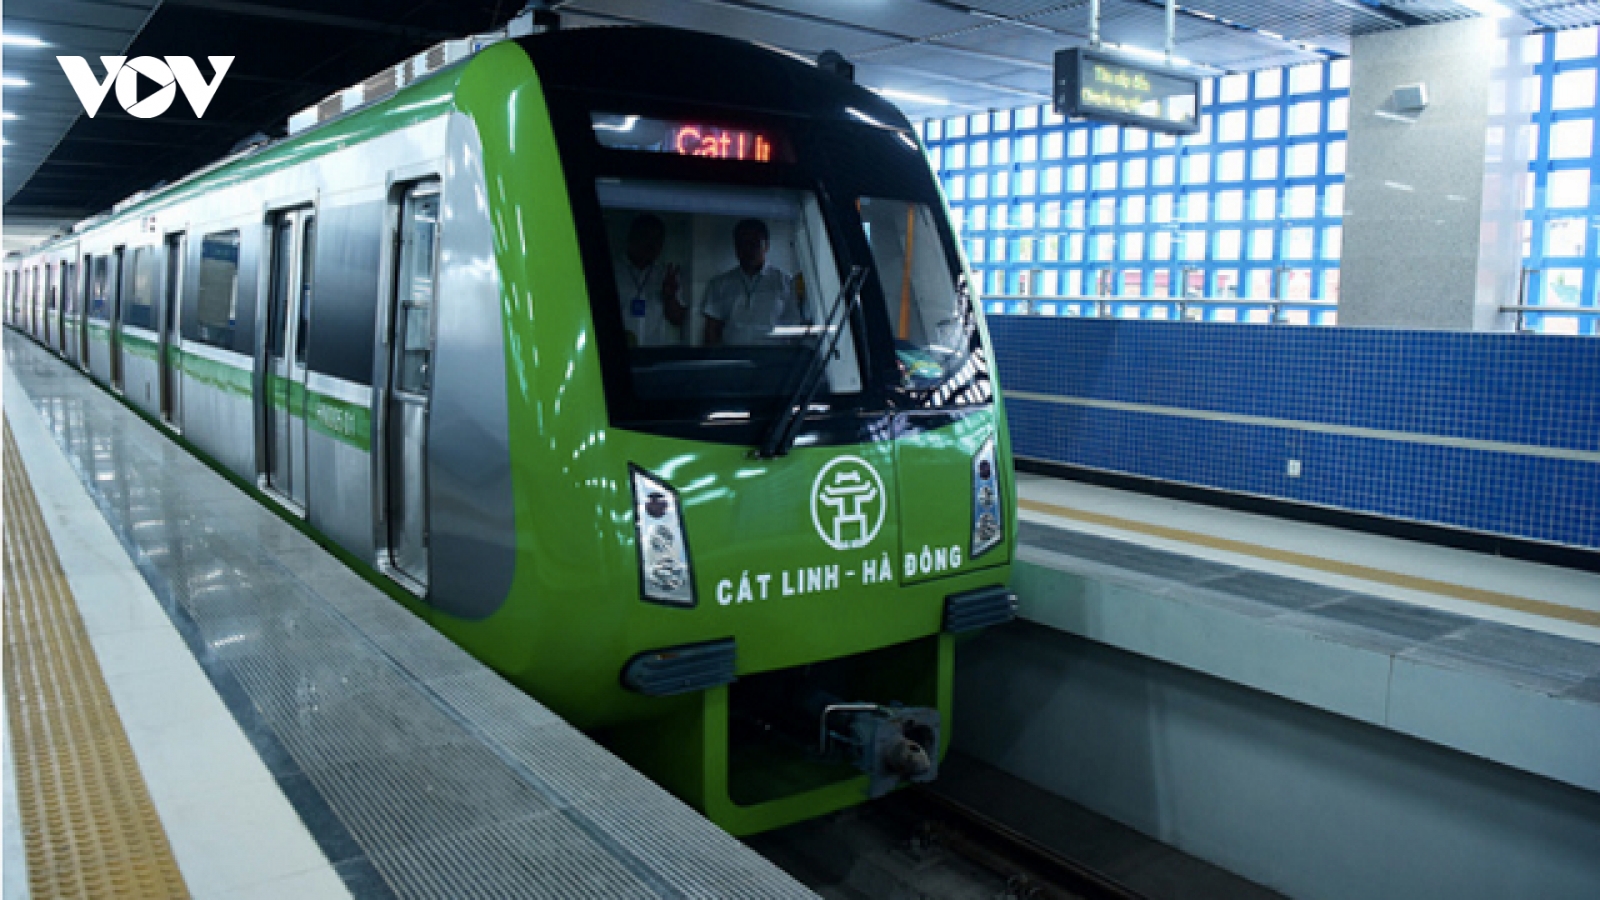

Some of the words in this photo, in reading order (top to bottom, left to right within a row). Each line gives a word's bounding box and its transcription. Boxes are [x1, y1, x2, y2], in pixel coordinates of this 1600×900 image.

[715, 570, 772, 606] CÁT
[781, 564, 839, 596] LINH
[862, 551, 893, 585] HÀ
[904, 544, 963, 578] ĐÔNG
